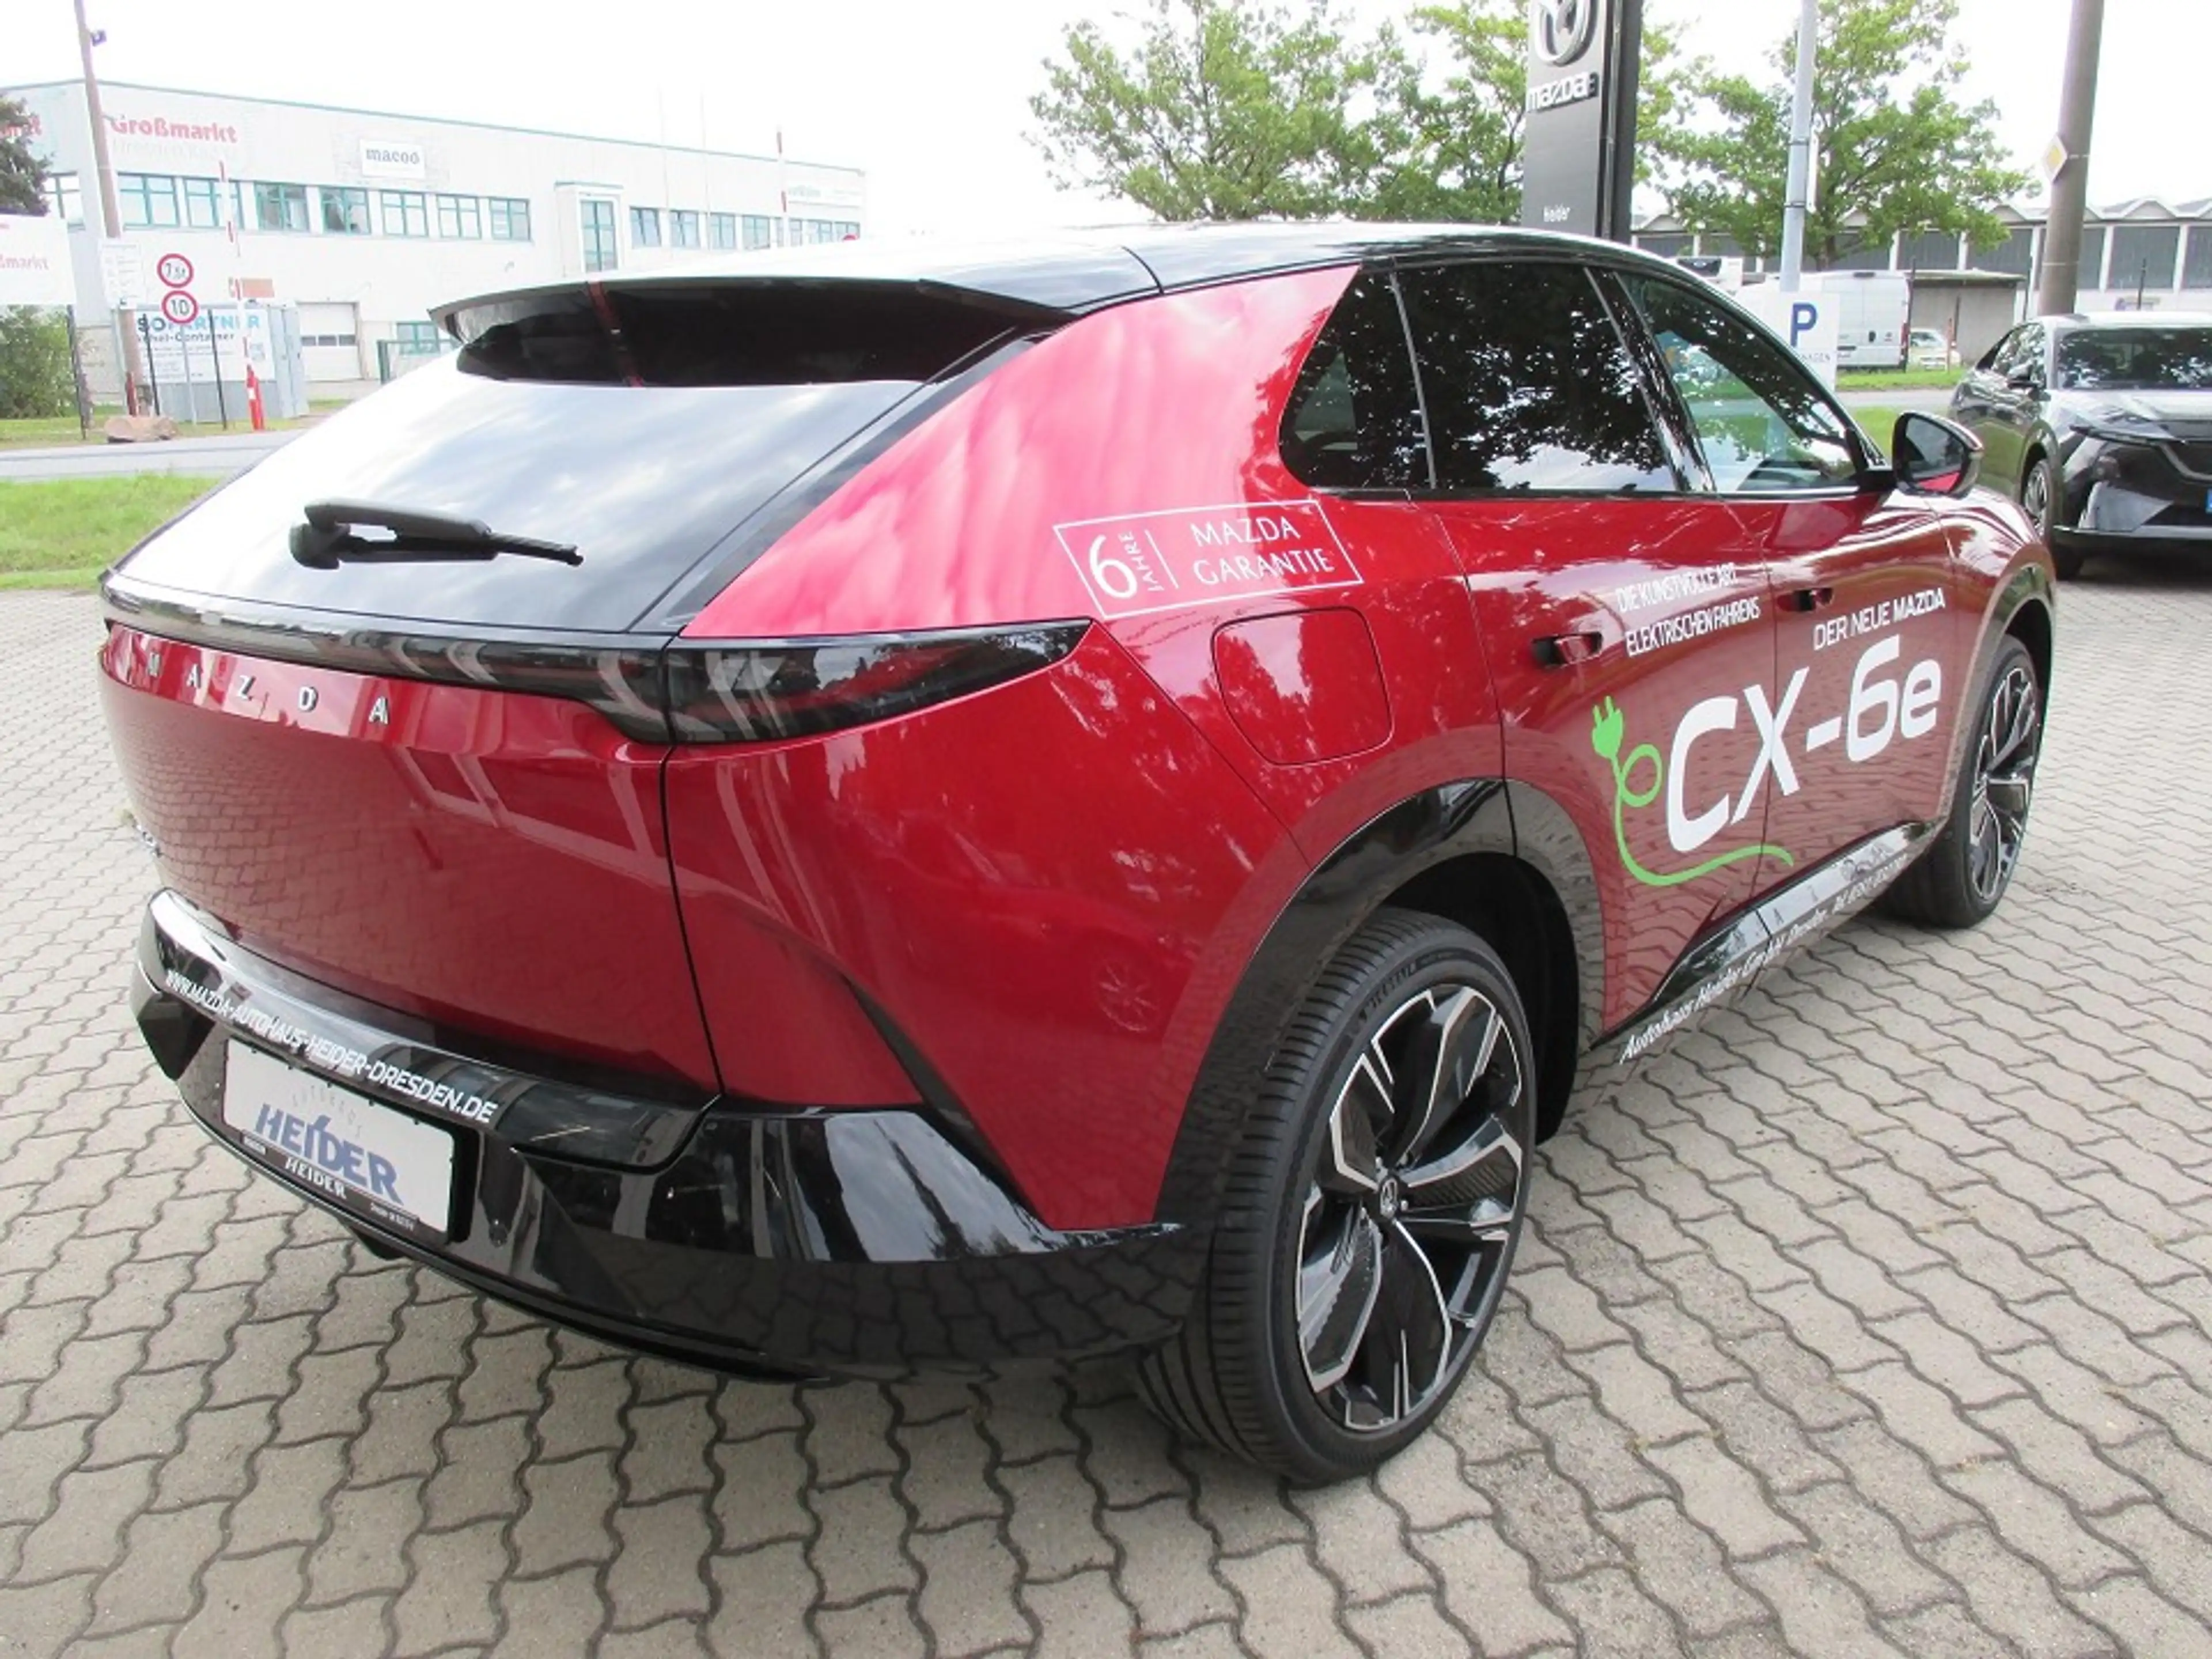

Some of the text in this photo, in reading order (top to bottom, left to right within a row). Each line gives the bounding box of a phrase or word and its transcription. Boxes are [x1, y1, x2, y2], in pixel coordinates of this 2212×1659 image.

[1527, 71, 1593, 112] mazda
[111, 116, 238, 143] Großmarkt
[171, 298, 190, 316] 10
[1790, 302, 1818, 347] P
[1190, 516, 1301, 547] MAZDA
[1089, 531, 1164, 599] 6 JAHRE
[1194, 548, 1335, 586] GARANTIE
[1624, 596, 1762, 658] ELEKTRISCHEN FAHRENS
[1814, 587, 1946, 651] DER NEUE MAZDA
[147, 652, 390, 725] MAZDA
[1666, 634, 1942, 853] CX-6e
[255, 1103, 404, 1206] HEIDER
[285, 1155, 347, 1199] HEIDER
